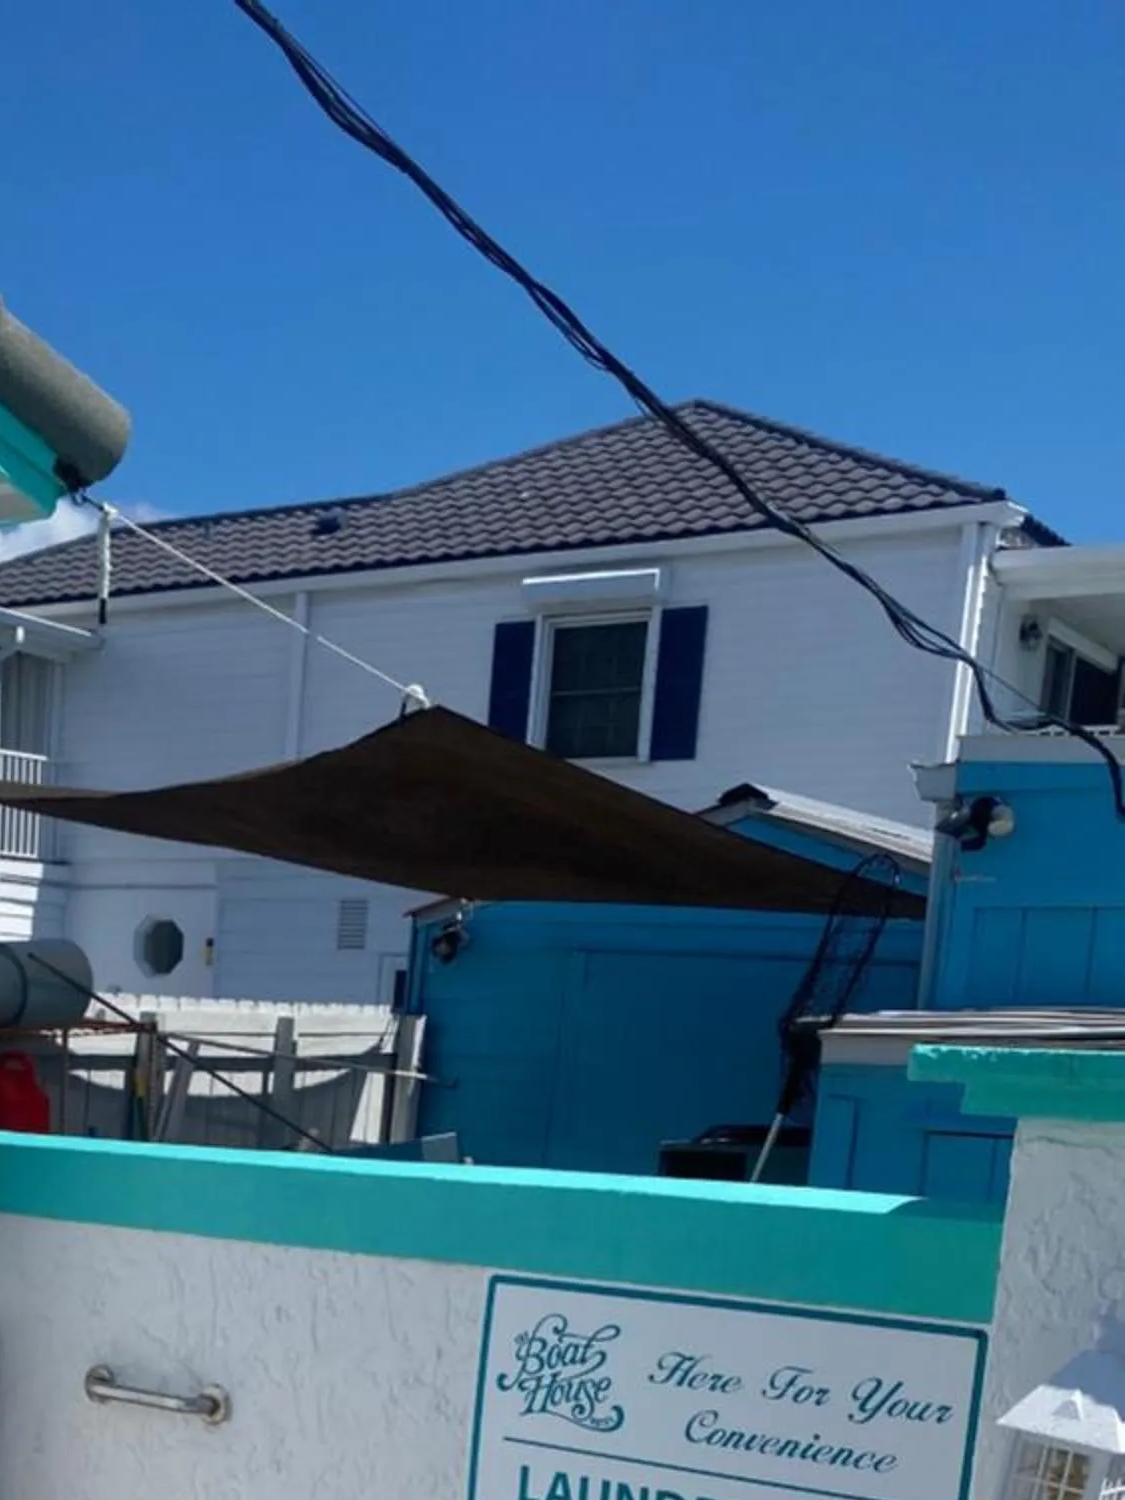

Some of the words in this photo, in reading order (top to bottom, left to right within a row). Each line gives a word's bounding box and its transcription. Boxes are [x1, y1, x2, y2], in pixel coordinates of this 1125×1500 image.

[497, 1313, 621, 1390] Boat
[516, 1371, 624, 1432] House
[647, 1351, 742, 1394] Here
[761, 1365, 831, 1407] For
[846, 1376, 954, 1425] Your
[684, 1409, 898, 1474] Convenience
